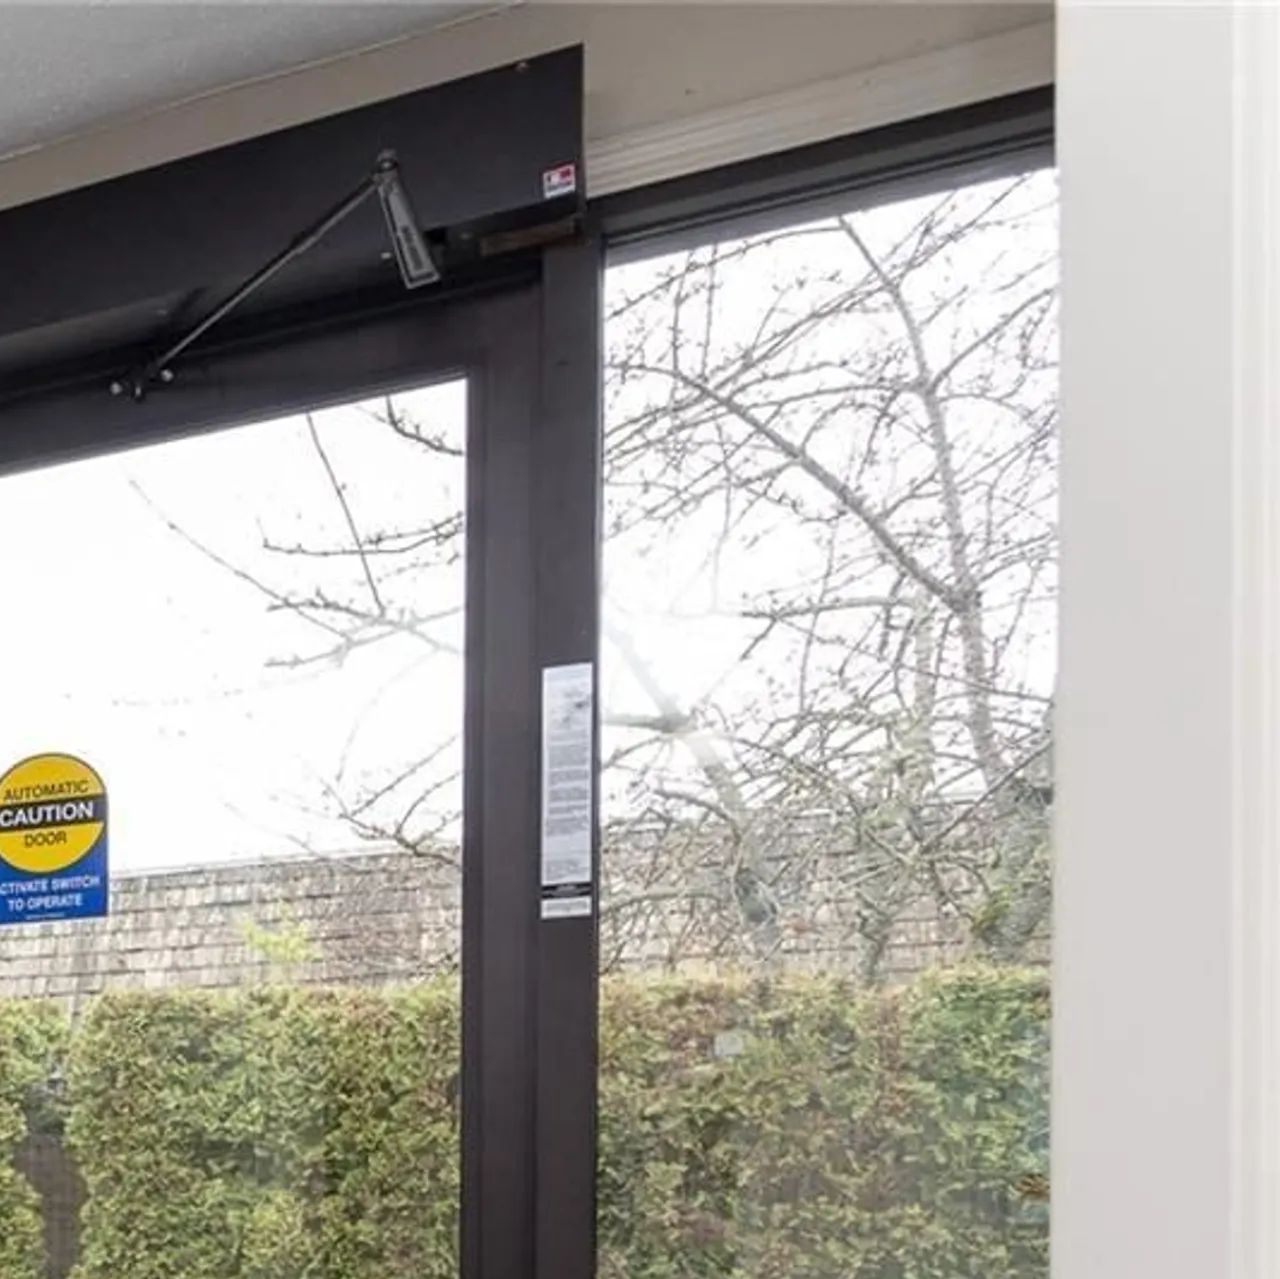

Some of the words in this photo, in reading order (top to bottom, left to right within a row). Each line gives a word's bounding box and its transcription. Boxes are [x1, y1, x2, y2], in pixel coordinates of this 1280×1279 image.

[3, 779, 89, 802] AUTOMATIC
[23, 831, 67, 848] DOOR
[51, 875, 100, 891] SWITCH
[8, 898, 24, 912] TO
[27, 893, 84, 910] OPERATE
